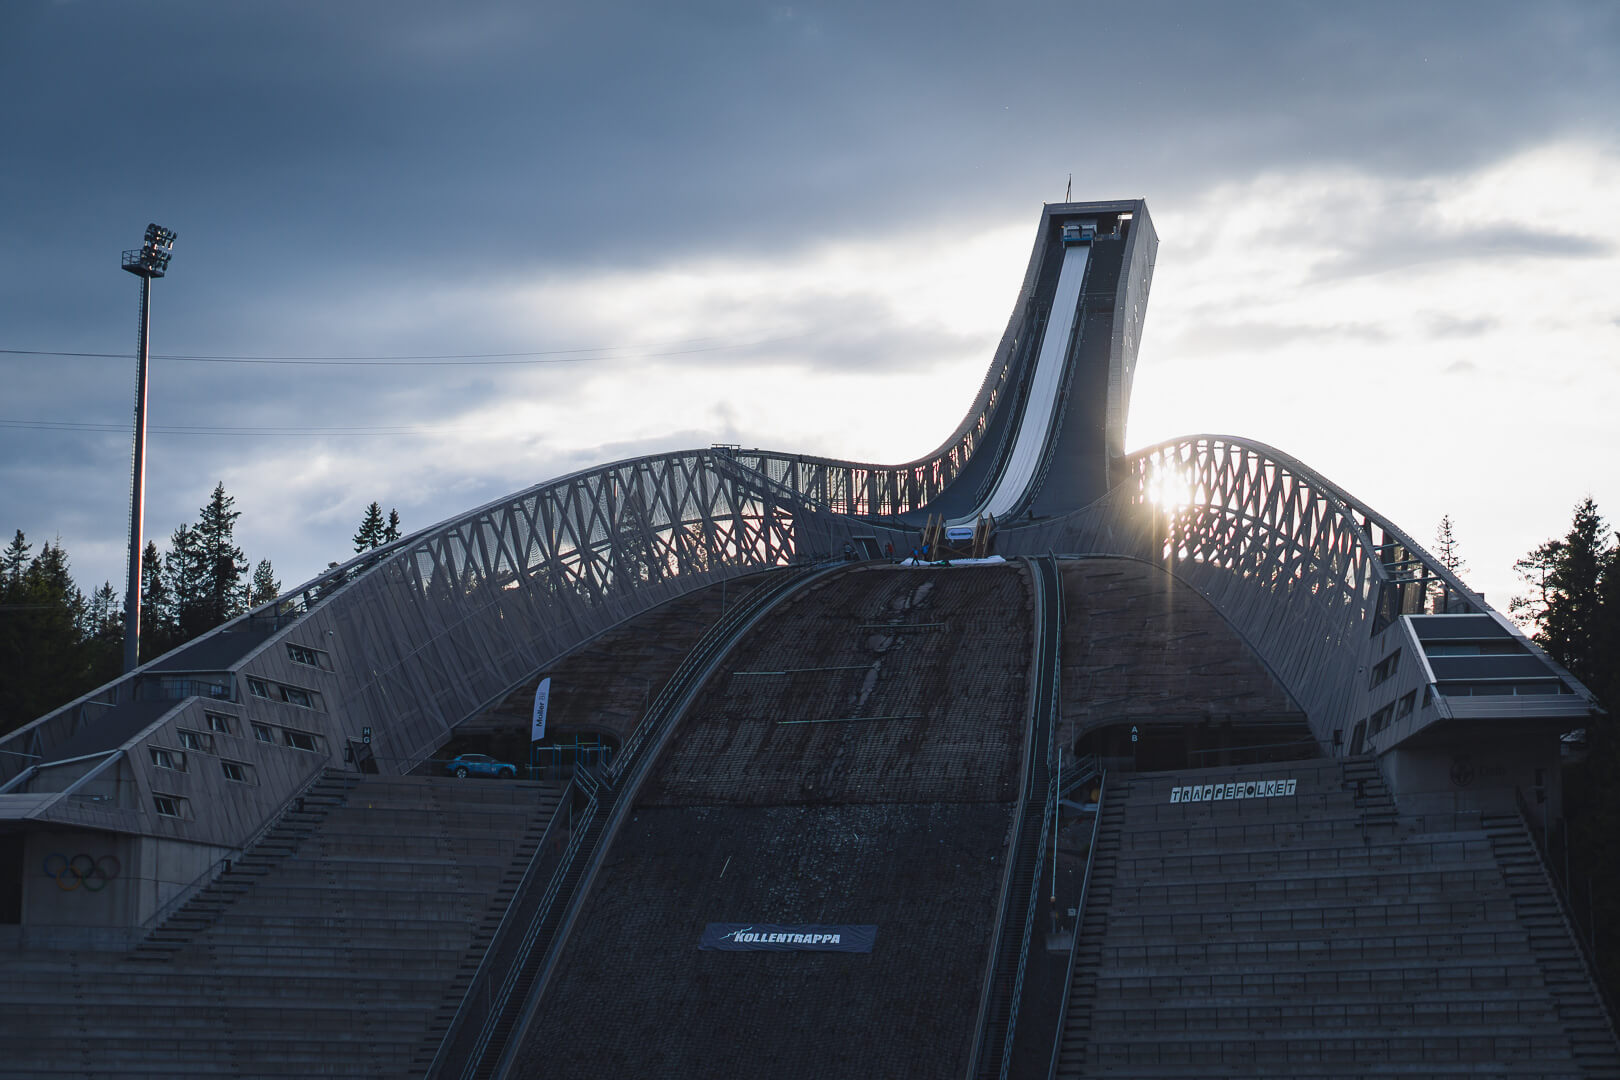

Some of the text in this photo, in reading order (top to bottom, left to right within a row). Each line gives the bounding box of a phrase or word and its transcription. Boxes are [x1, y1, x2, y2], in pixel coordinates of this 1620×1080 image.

[364, 727, 370, 735] H
[1131, 725, 1138, 733] A
[363, 736, 370, 744] G
[1131, 734, 1138, 742] B
[1171, 783, 1295, 801] TRAPPEFOLKET
[734, 933, 841, 944] KOLLENTRAPPA
